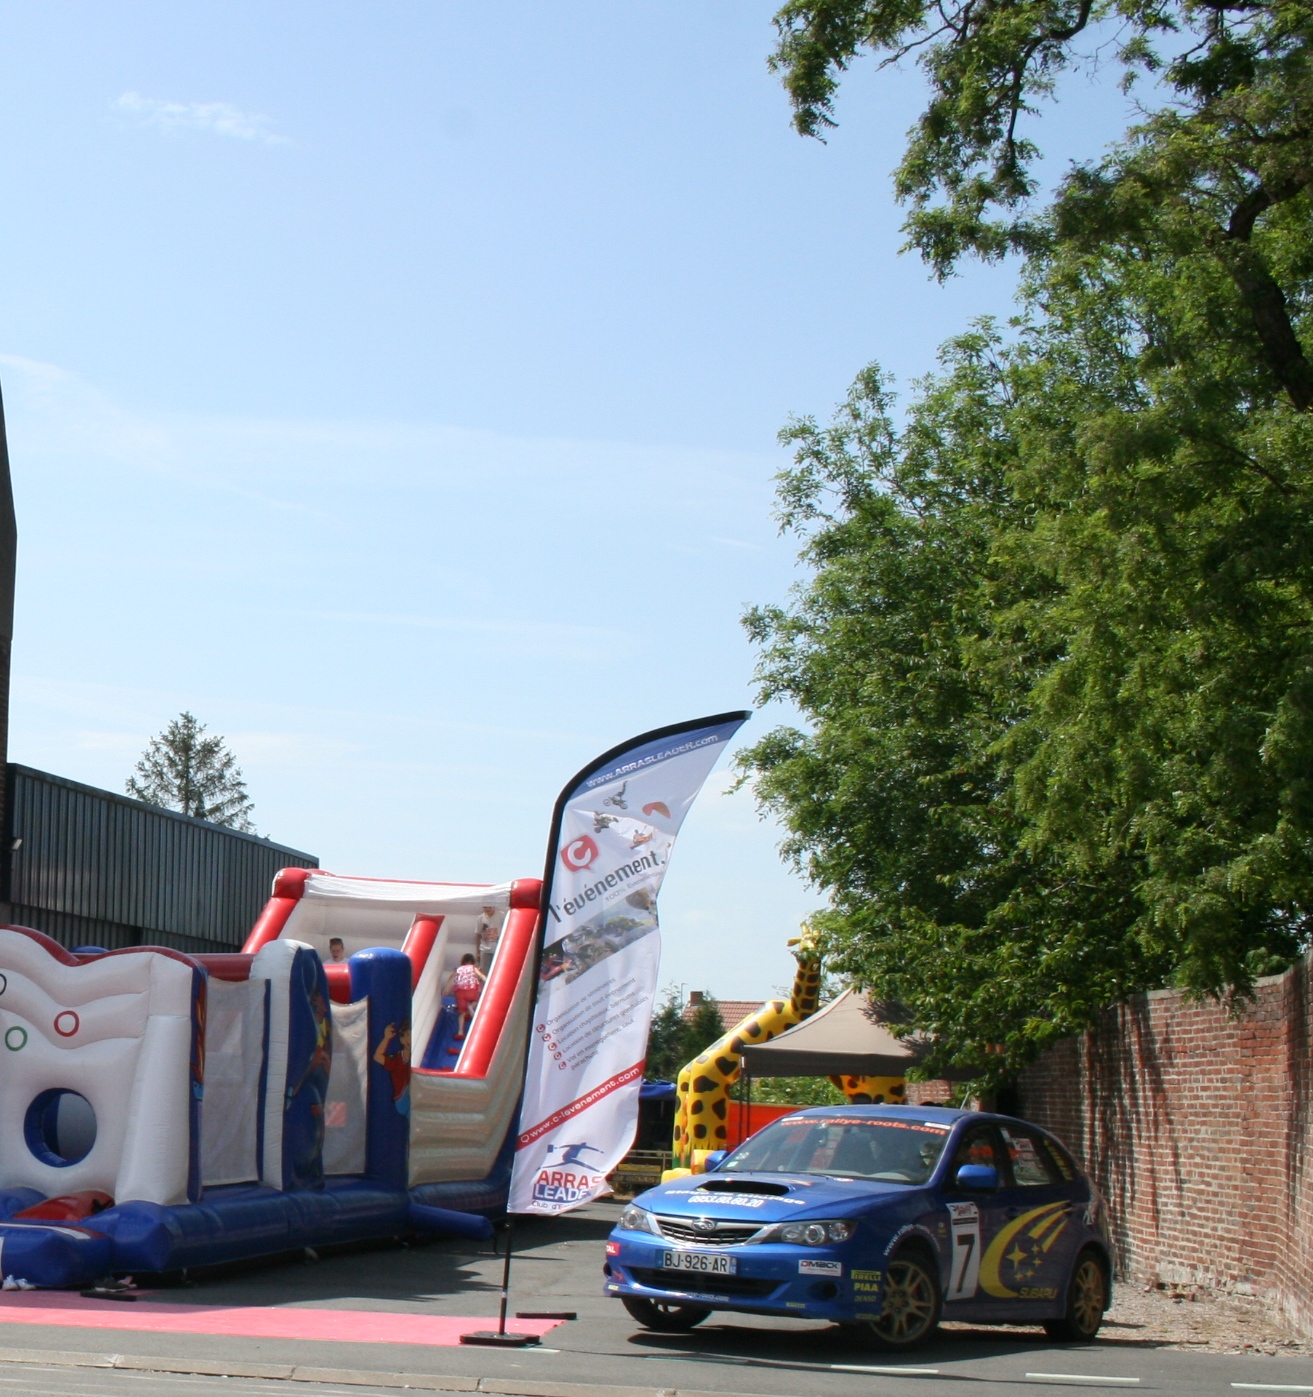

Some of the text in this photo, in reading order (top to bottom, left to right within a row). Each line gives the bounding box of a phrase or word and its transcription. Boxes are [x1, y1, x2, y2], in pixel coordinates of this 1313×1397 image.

[780, 1117, 948, 1136] www.rallye-roots.com
[664, 1252, 728, 1273] BJ-926-AR
[956, 1233, 975, 1293] 7
[853, 1282, 878, 1291] PIAA
[1018, 1287, 1058, 1299] SUBARU
